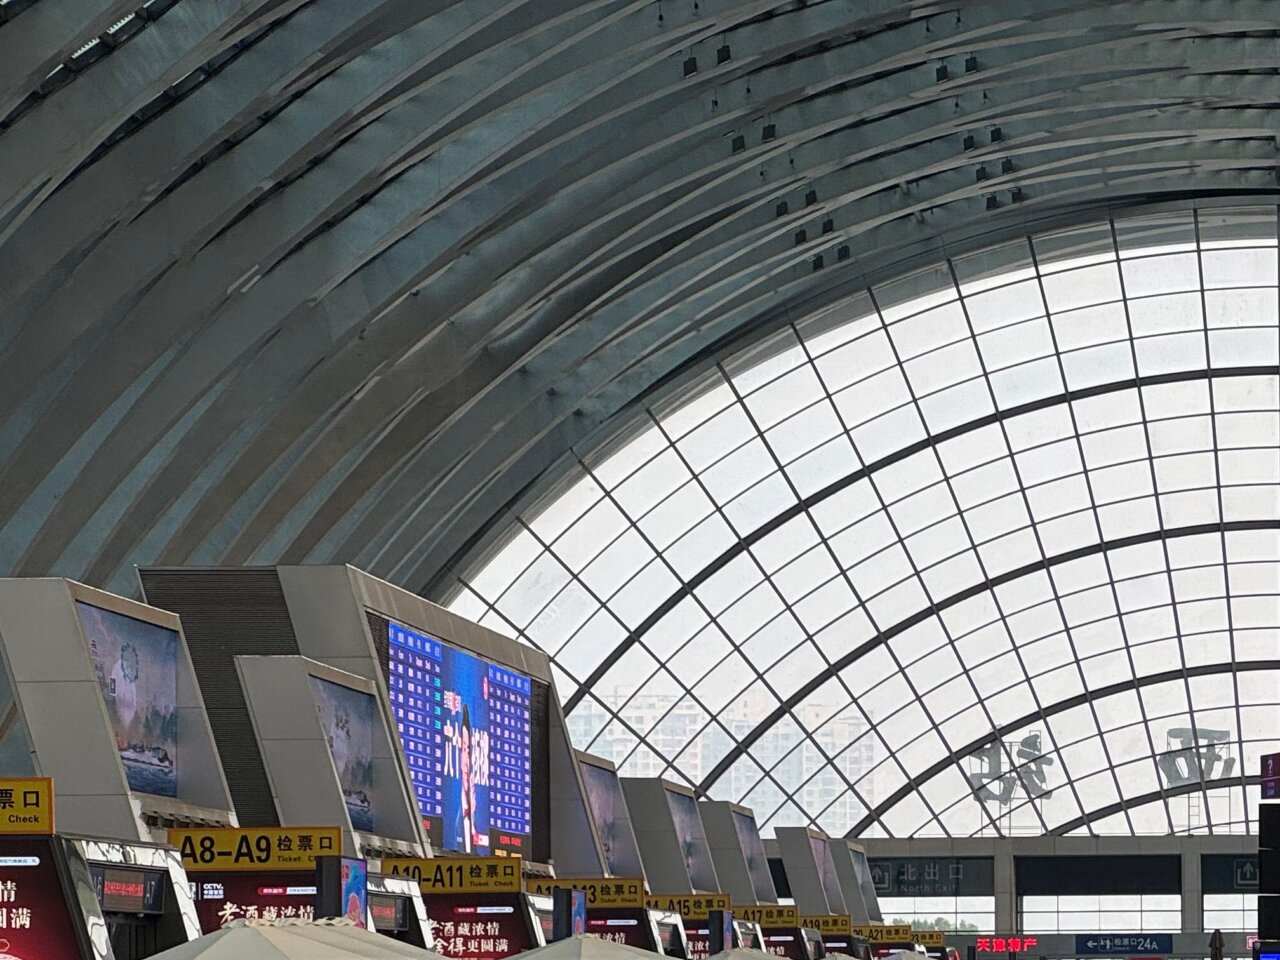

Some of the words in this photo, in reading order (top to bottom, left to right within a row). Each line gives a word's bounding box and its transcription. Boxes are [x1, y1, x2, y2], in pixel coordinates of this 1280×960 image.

[8, 814, 39, 823] Check
[181, 835, 271, 864] A8-A9
[277, 835, 332, 852] 检票口
[469, 864, 514, 878] 检票口
[900, 862, 963, 880] 北出口
[600, 884, 638, 895] 检票口
[901, 884, 930, 892] North
[935, 884, 956, 892] Exit
[976, 937, 1038, 952] 天津特产
[1137, 938, 1158, 950] 24A
